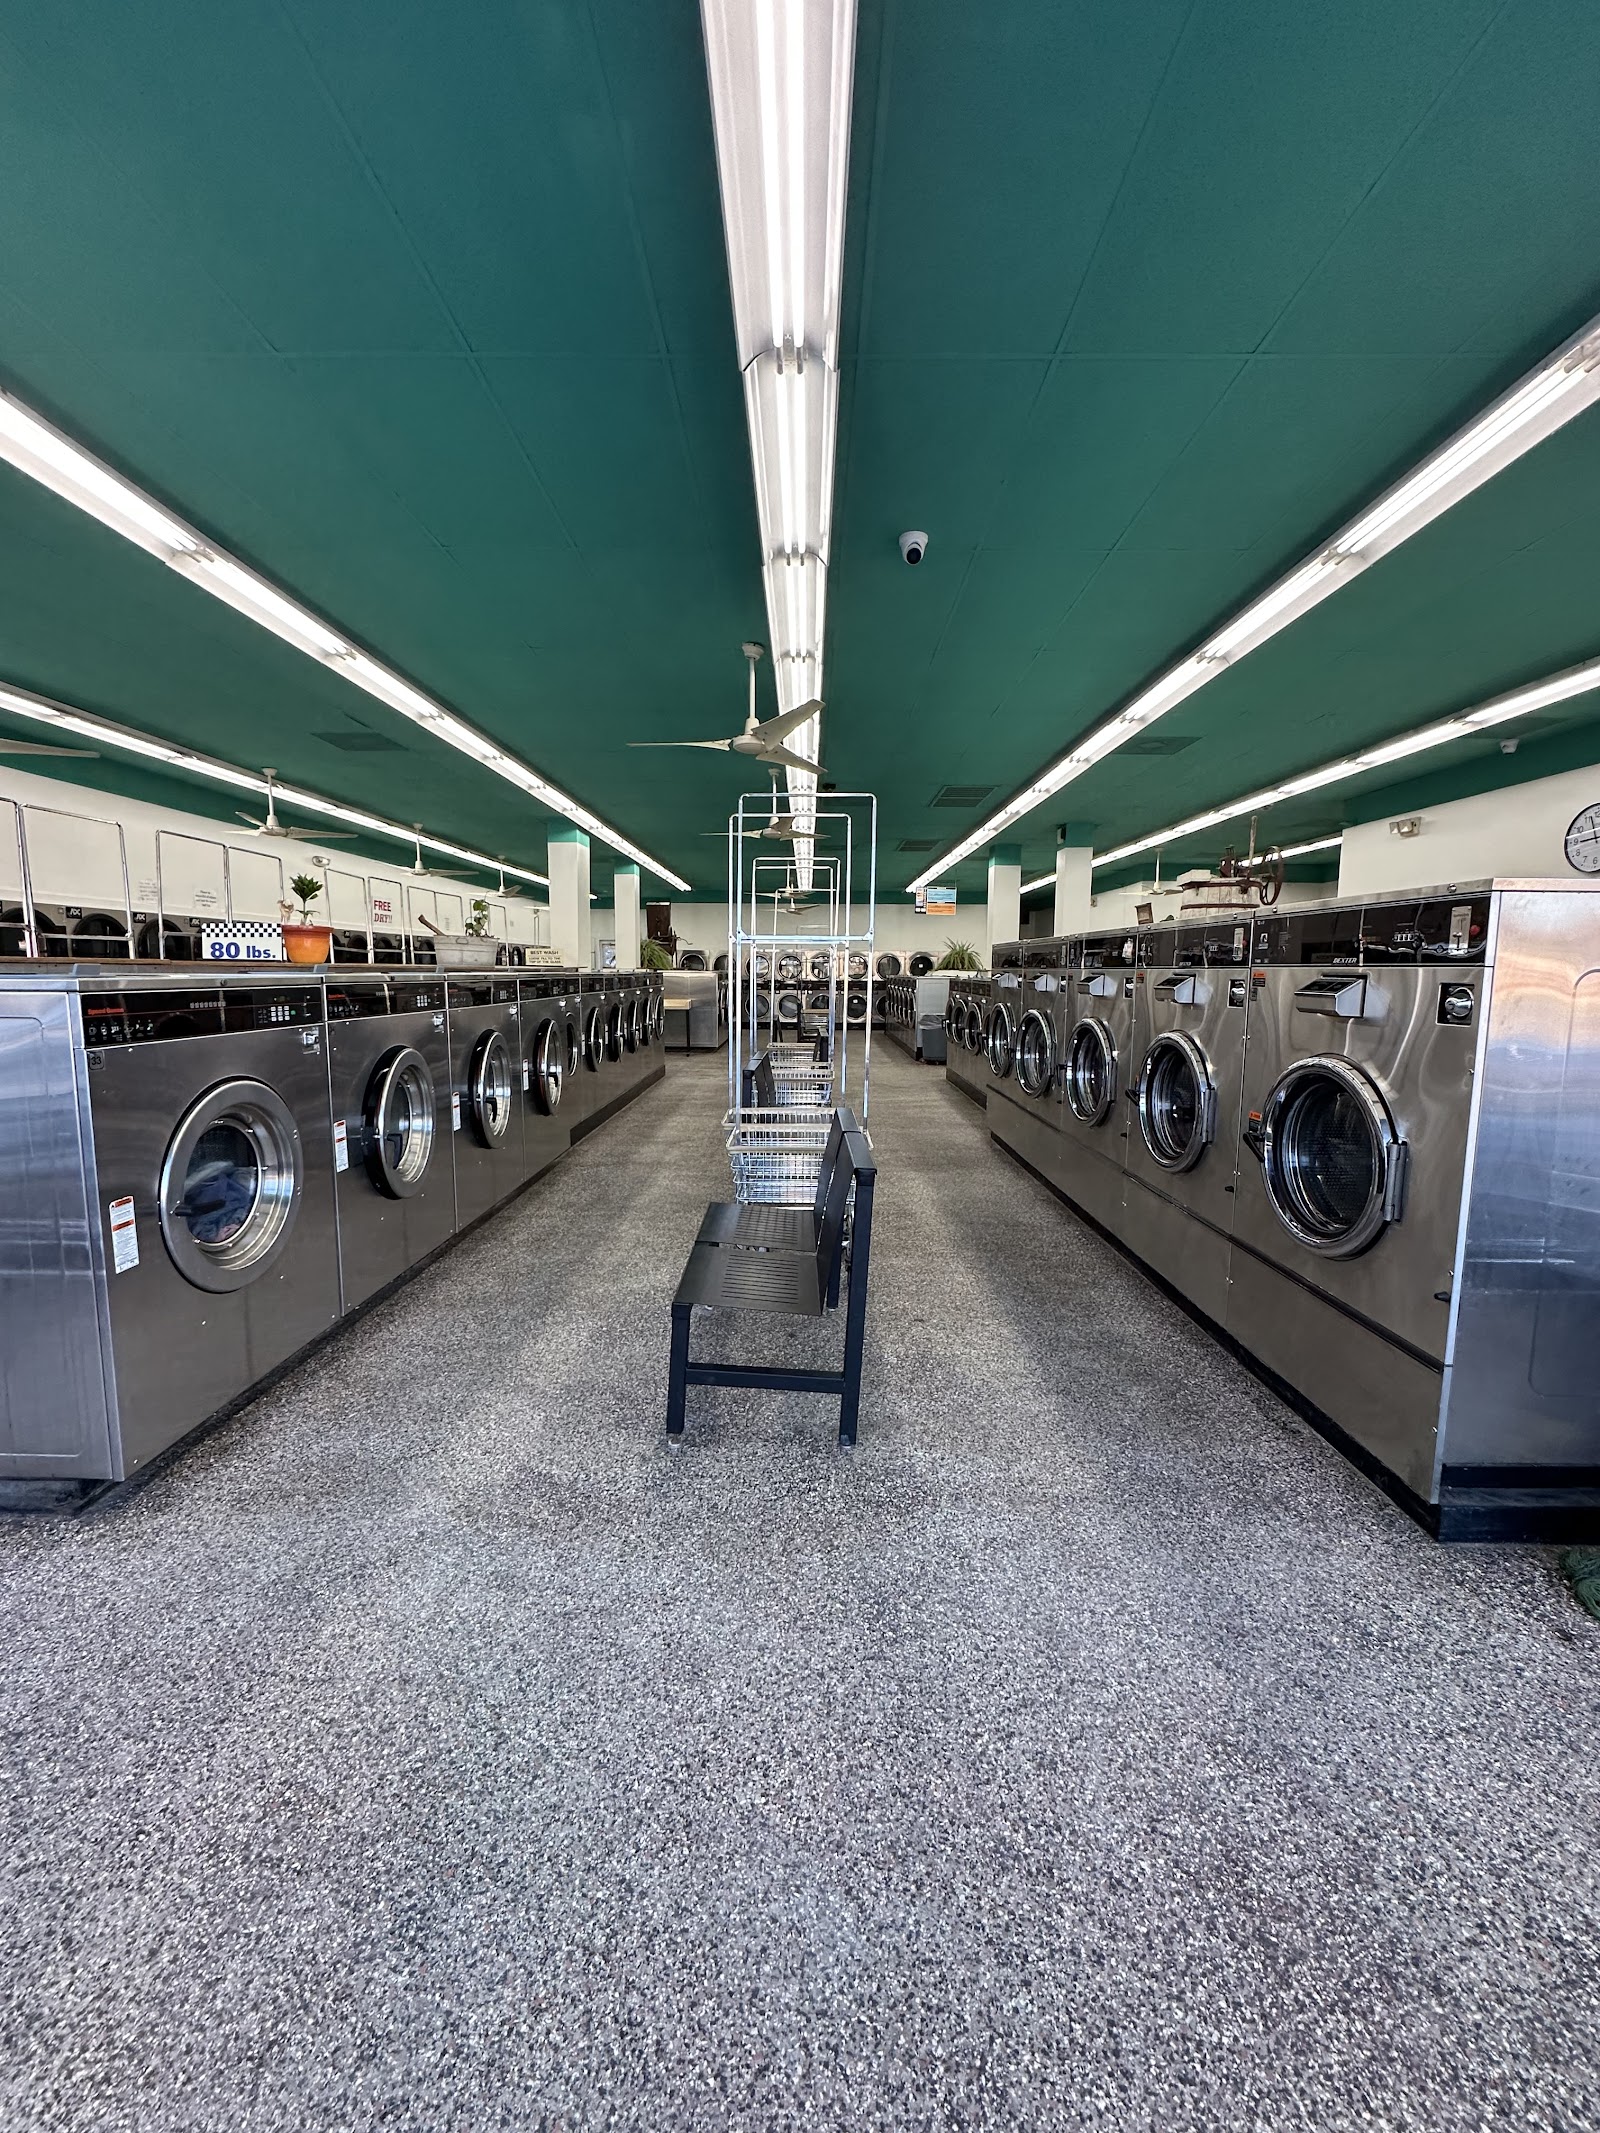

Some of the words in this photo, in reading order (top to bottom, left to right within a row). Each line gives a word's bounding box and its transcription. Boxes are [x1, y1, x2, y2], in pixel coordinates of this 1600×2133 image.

[373, 900, 391, 912] FREE
[210, 942, 241, 959] 80
[246, 945, 276, 958] lbs.
[91, 1056, 102, 1066] 33
